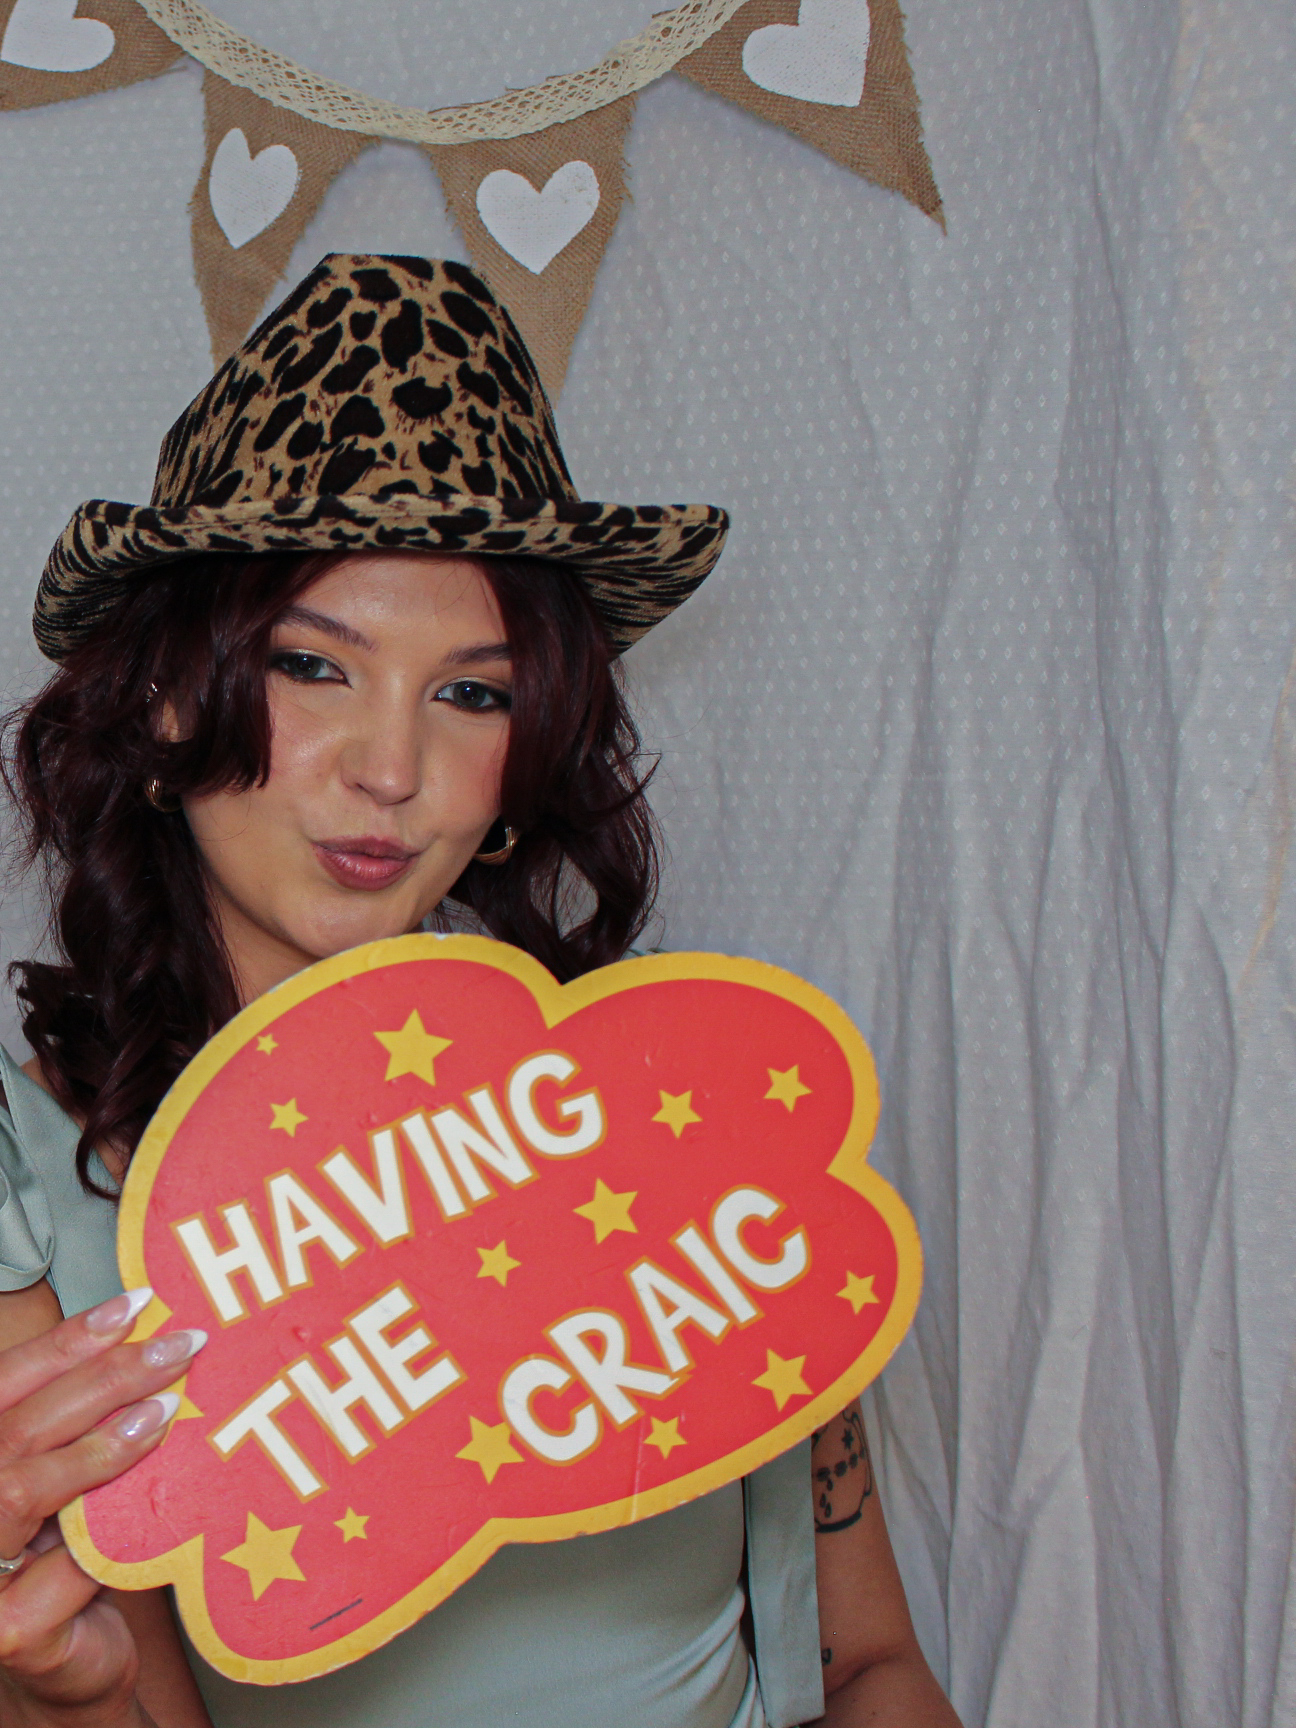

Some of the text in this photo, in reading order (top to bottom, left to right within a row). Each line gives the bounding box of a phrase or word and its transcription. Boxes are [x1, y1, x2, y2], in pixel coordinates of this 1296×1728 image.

[172, 1052, 606, 1327] HAVING
[500, 1185, 808, 1465] CRAIC
[210, 1283, 466, 1499] THE
